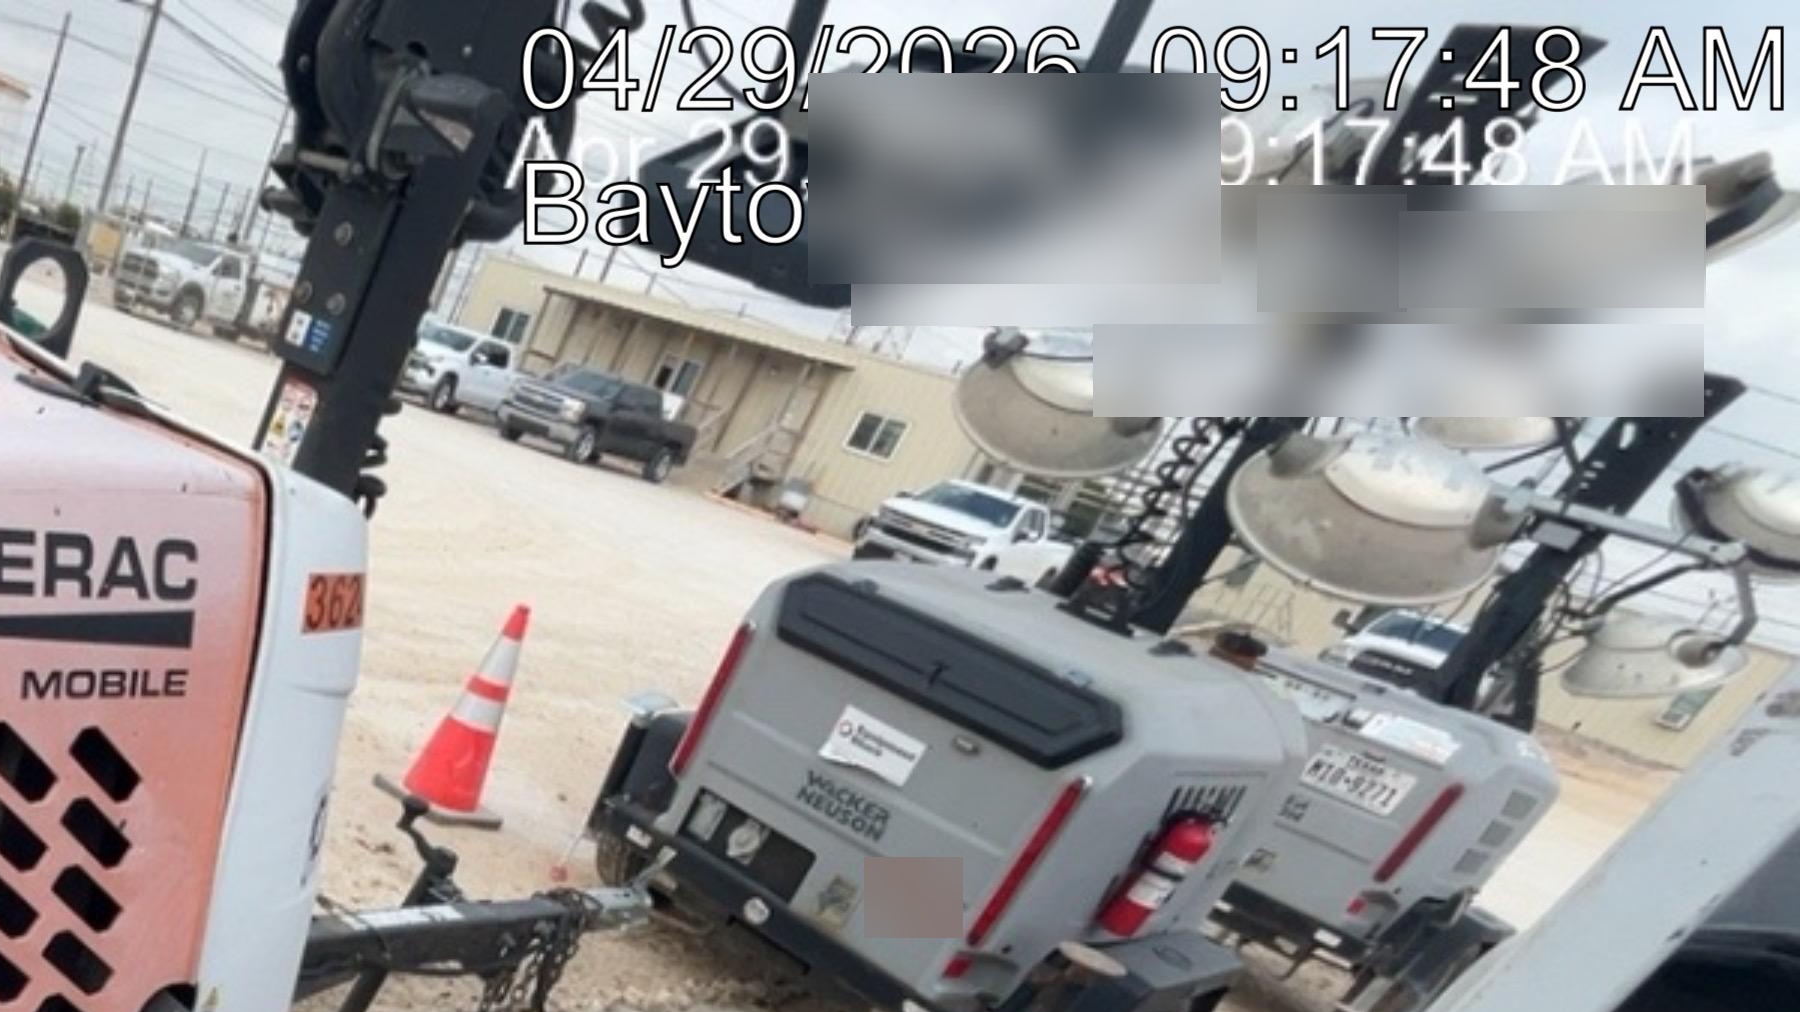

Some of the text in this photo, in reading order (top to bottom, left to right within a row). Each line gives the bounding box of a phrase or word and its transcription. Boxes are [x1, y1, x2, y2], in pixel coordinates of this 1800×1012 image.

[305, 574, 362, 630] 362
[20, 669, 189, 700] MOBILE
[797, 786, 883, 841] NEUSON
[807, 769, 891, 824] WACKER
